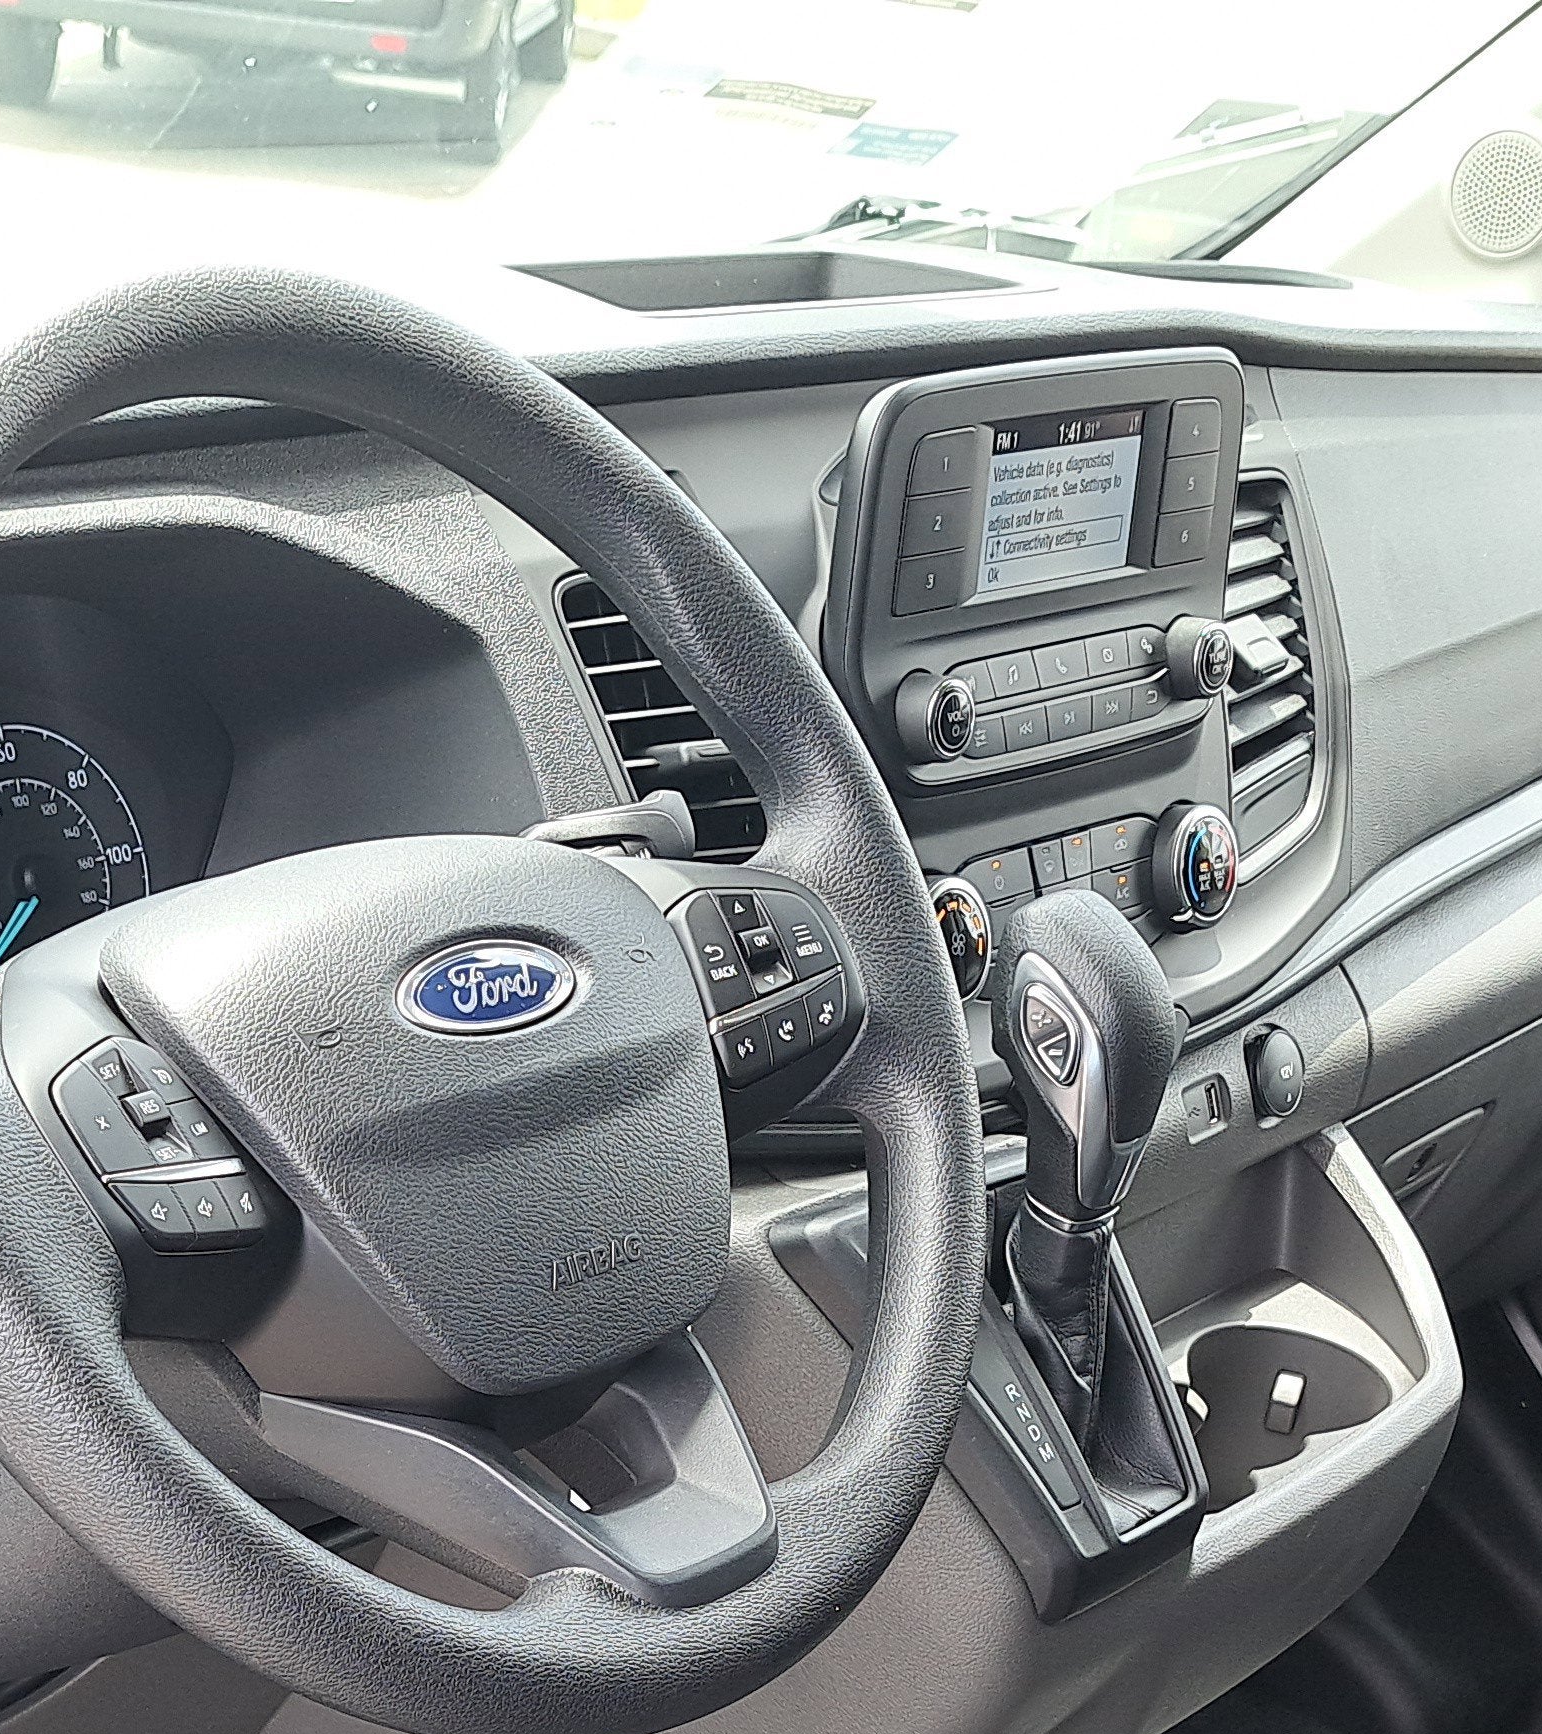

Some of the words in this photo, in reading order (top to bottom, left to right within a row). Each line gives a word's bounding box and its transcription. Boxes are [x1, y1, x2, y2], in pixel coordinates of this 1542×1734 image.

[996, 432, 1011, 450] FM
[1012, 431, 1019, 448] 1
[1058, 421, 1082, 445] 1:41
[1191, 425, 1200, 438] 4
[942, 456, 949, 473] 1
[993, 461, 1025, 483] Vehicle
[1025, 461, 1045, 477] data
[1065, 450, 1115, 475] diagnostics)
[990, 487, 1032, 508] collection
[1062, 480, 1079, 498] See
[1079, 476, 1112, 496] Settings
[1186, 476, 1196, 492] 5
[933, 515, 943, 532] 2
[987, 513, 1015, 536] adjust
[1015, 511, 1032, 527] and
[1033, 509, 1045, 525] for
[1003, 532, 1054, 556] Connectivity
[1055, 528, 1088, 548] settings
[1180, 528, 1190, 544] 6
[925, 573, 935, 590] 3
[946, 710, 966, 723] VOL
[66, 768, 88, 789] 80
[10, 794, 31, 809] 100
[40, 802, 59, 817] 120
[62, 825, 81, 840] 140
[76, 856, 95, 870] 160
[105, 843, 132, 866] 100
[752, 934, 770, 948] OK
[795, 940, 824, 958] MENU
[709, 963, 739, 982] BACK
[447, 961, 539, 1015] Ford
[139, 1098, 160, 1115] RES
[189, 1120, 209, 1137] LIM
[550, 1232, 646, 1293] AIRBAG
[1004, 1383, 1021, 1402] R
[1015, 1402, 1032, 1423] N
[1027, 1424, 1041, 1442] D
[1038, 1442, 1056, 1463] M
